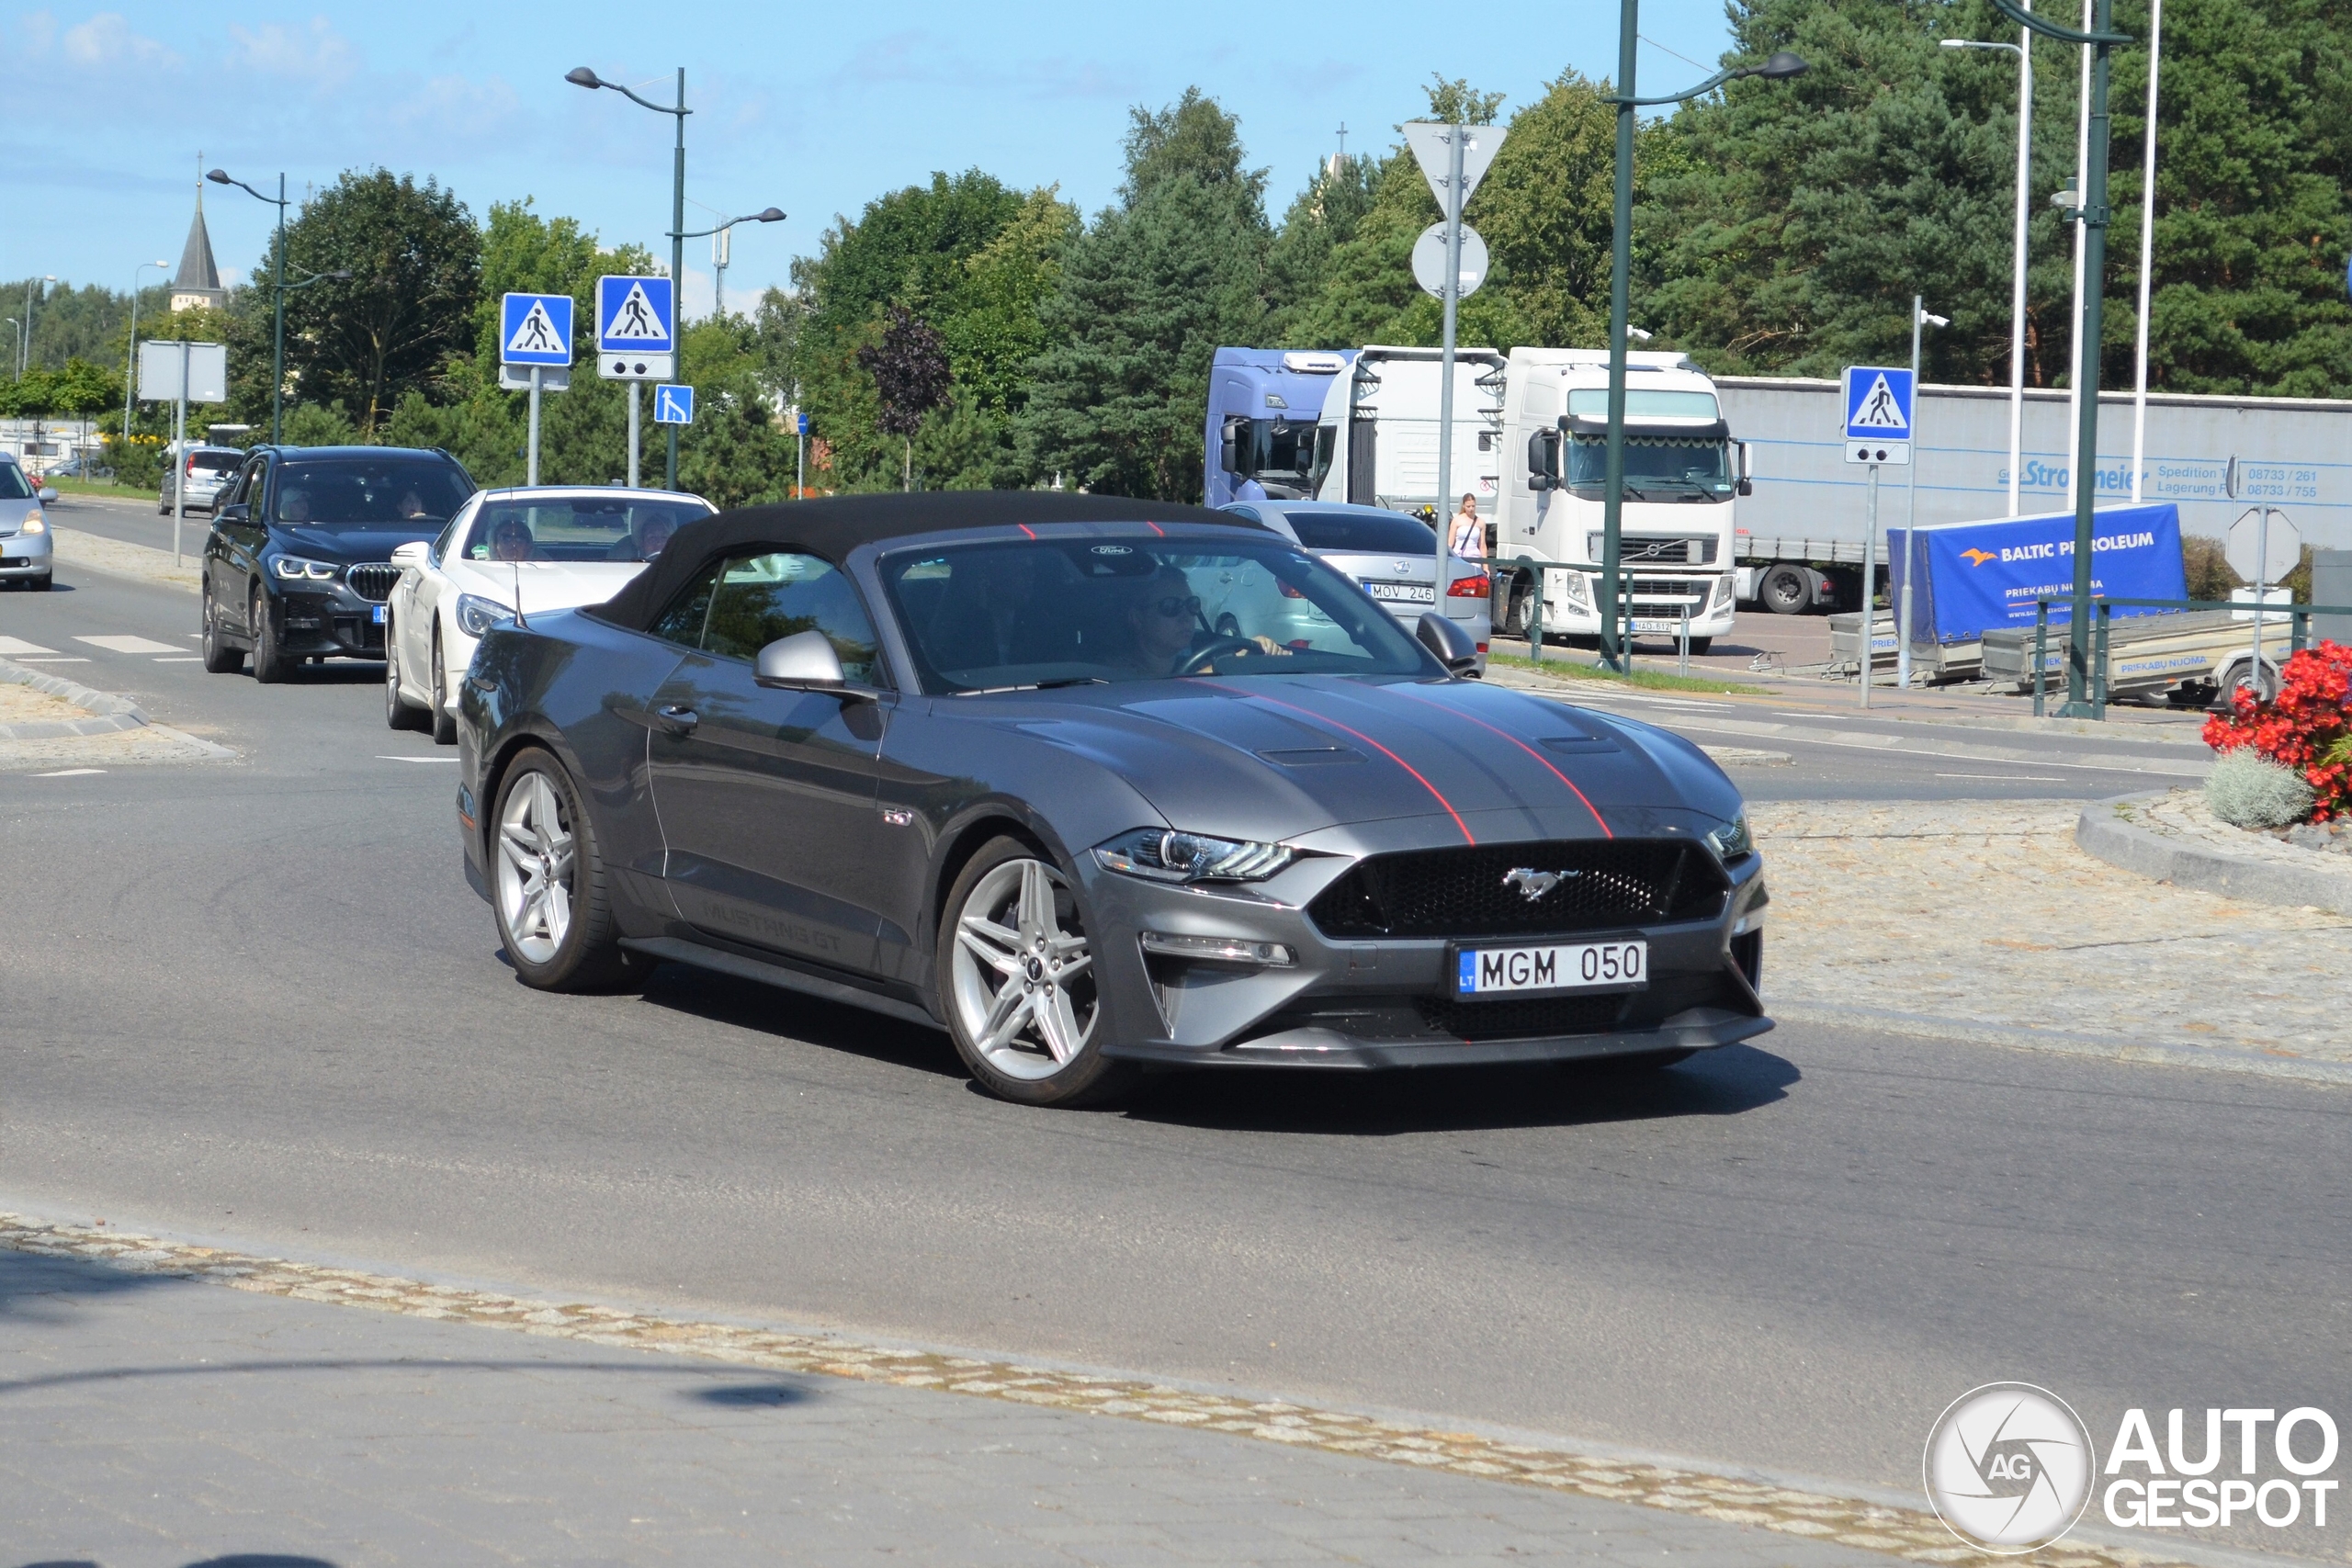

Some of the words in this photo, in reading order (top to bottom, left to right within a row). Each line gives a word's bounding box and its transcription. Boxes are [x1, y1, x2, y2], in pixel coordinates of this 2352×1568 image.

[1998, 468, 2026, 480] Ger.
[2158, 466, 2217, 479] Spedition
[2248, 468, 2285, 479] 08733
[2295, 471, 2317, 481] 261
[2157, 481, 2215, 496] Lagerung
[2247, 484, 2284, 495] 08733
[2295, 487, 2317, 497] 755
[2001, 543, 2054, 562] BALTIC
[2059, 532, 2154, 556] PEROLEUM
[1374, 586, 1400, 597] MOV
[1409, 587, 1432, 600] 246
[2005, 584, 2059, 598] PRIEKABŲ
[1871, 639, 1898, 648] PRIEK
[2121, 660, 2167, 673] PRIEKABŲ
[2169, 656, 2207, 668] NUOMA
[704, 904, 808, 944] MUSTANG
[813, 931, 841, 952] GT
[1459, 976, 1475, 987] LT
[1482, 950, 1555, 987] MGM
[1581, 944, 1640, 981] 050
